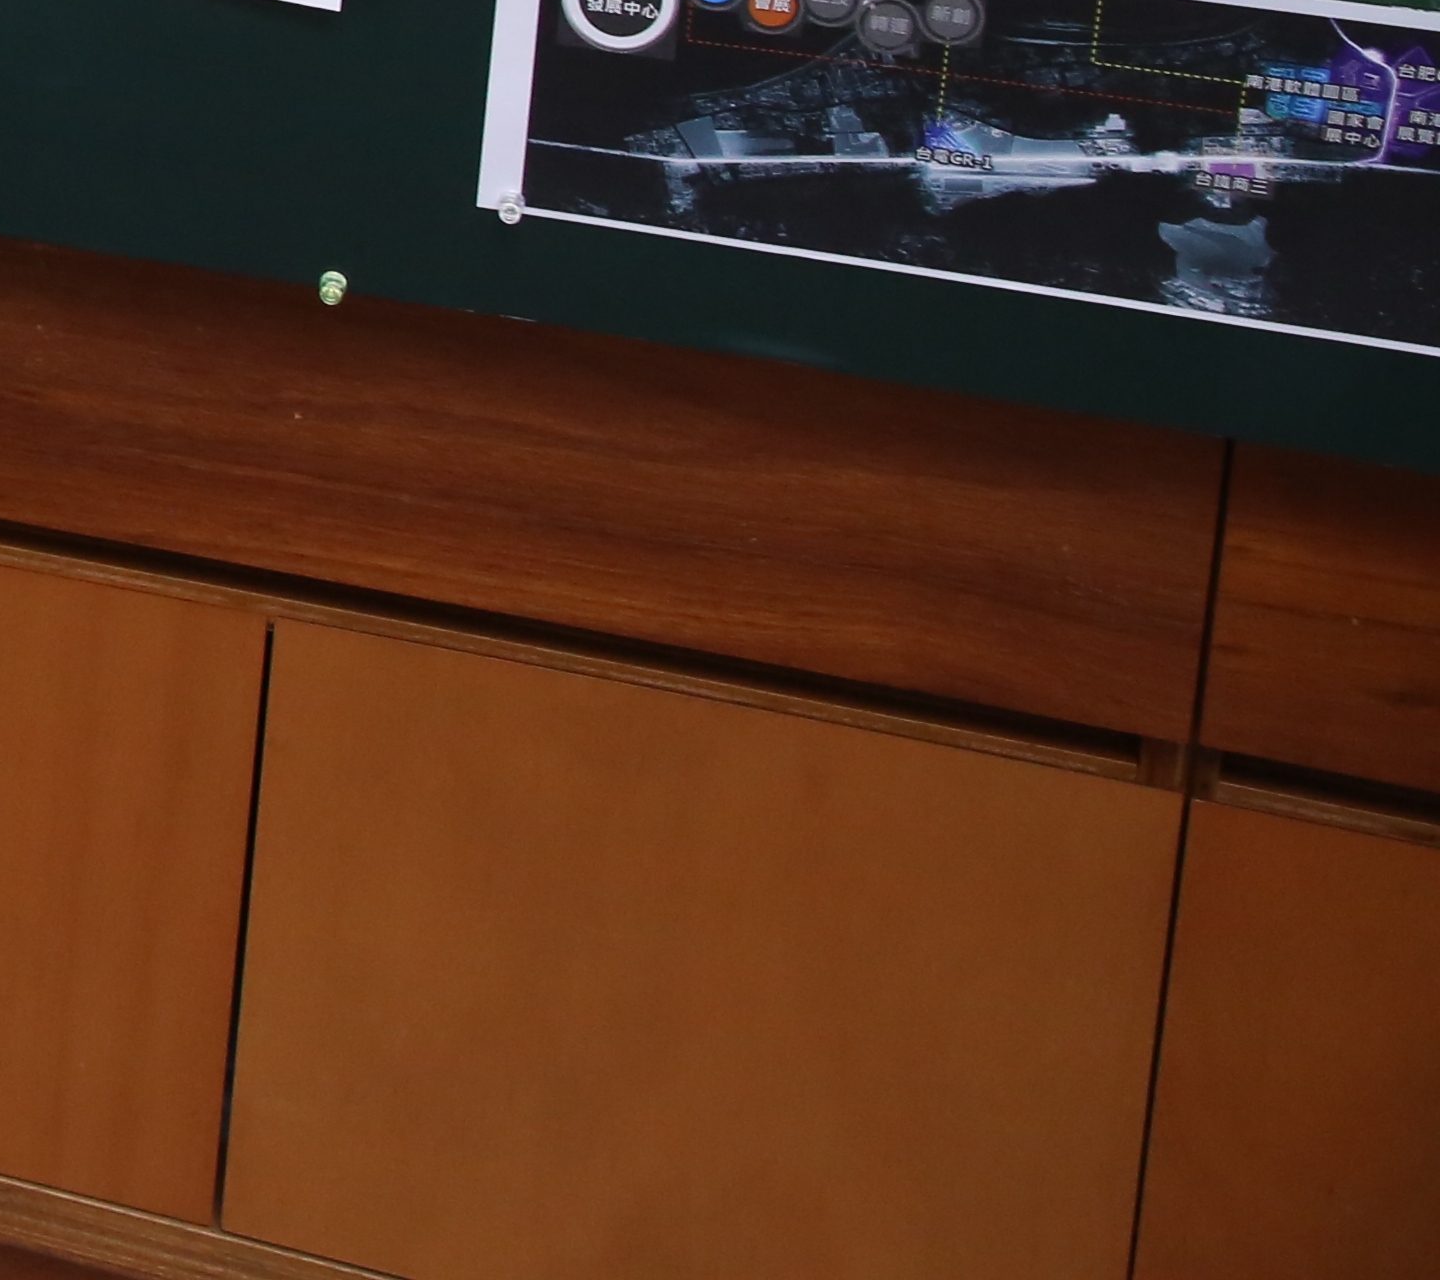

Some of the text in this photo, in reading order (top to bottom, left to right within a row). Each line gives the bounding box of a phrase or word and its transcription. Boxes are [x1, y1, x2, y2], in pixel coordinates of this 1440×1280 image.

[930, 3, 971, 26] 新創
[1246, 74, 1360, 101] 南港軟體園區
[915, 145, 993, 173] 台電CR-1
[1195, 175, 1268, 195] 台鐵商三
